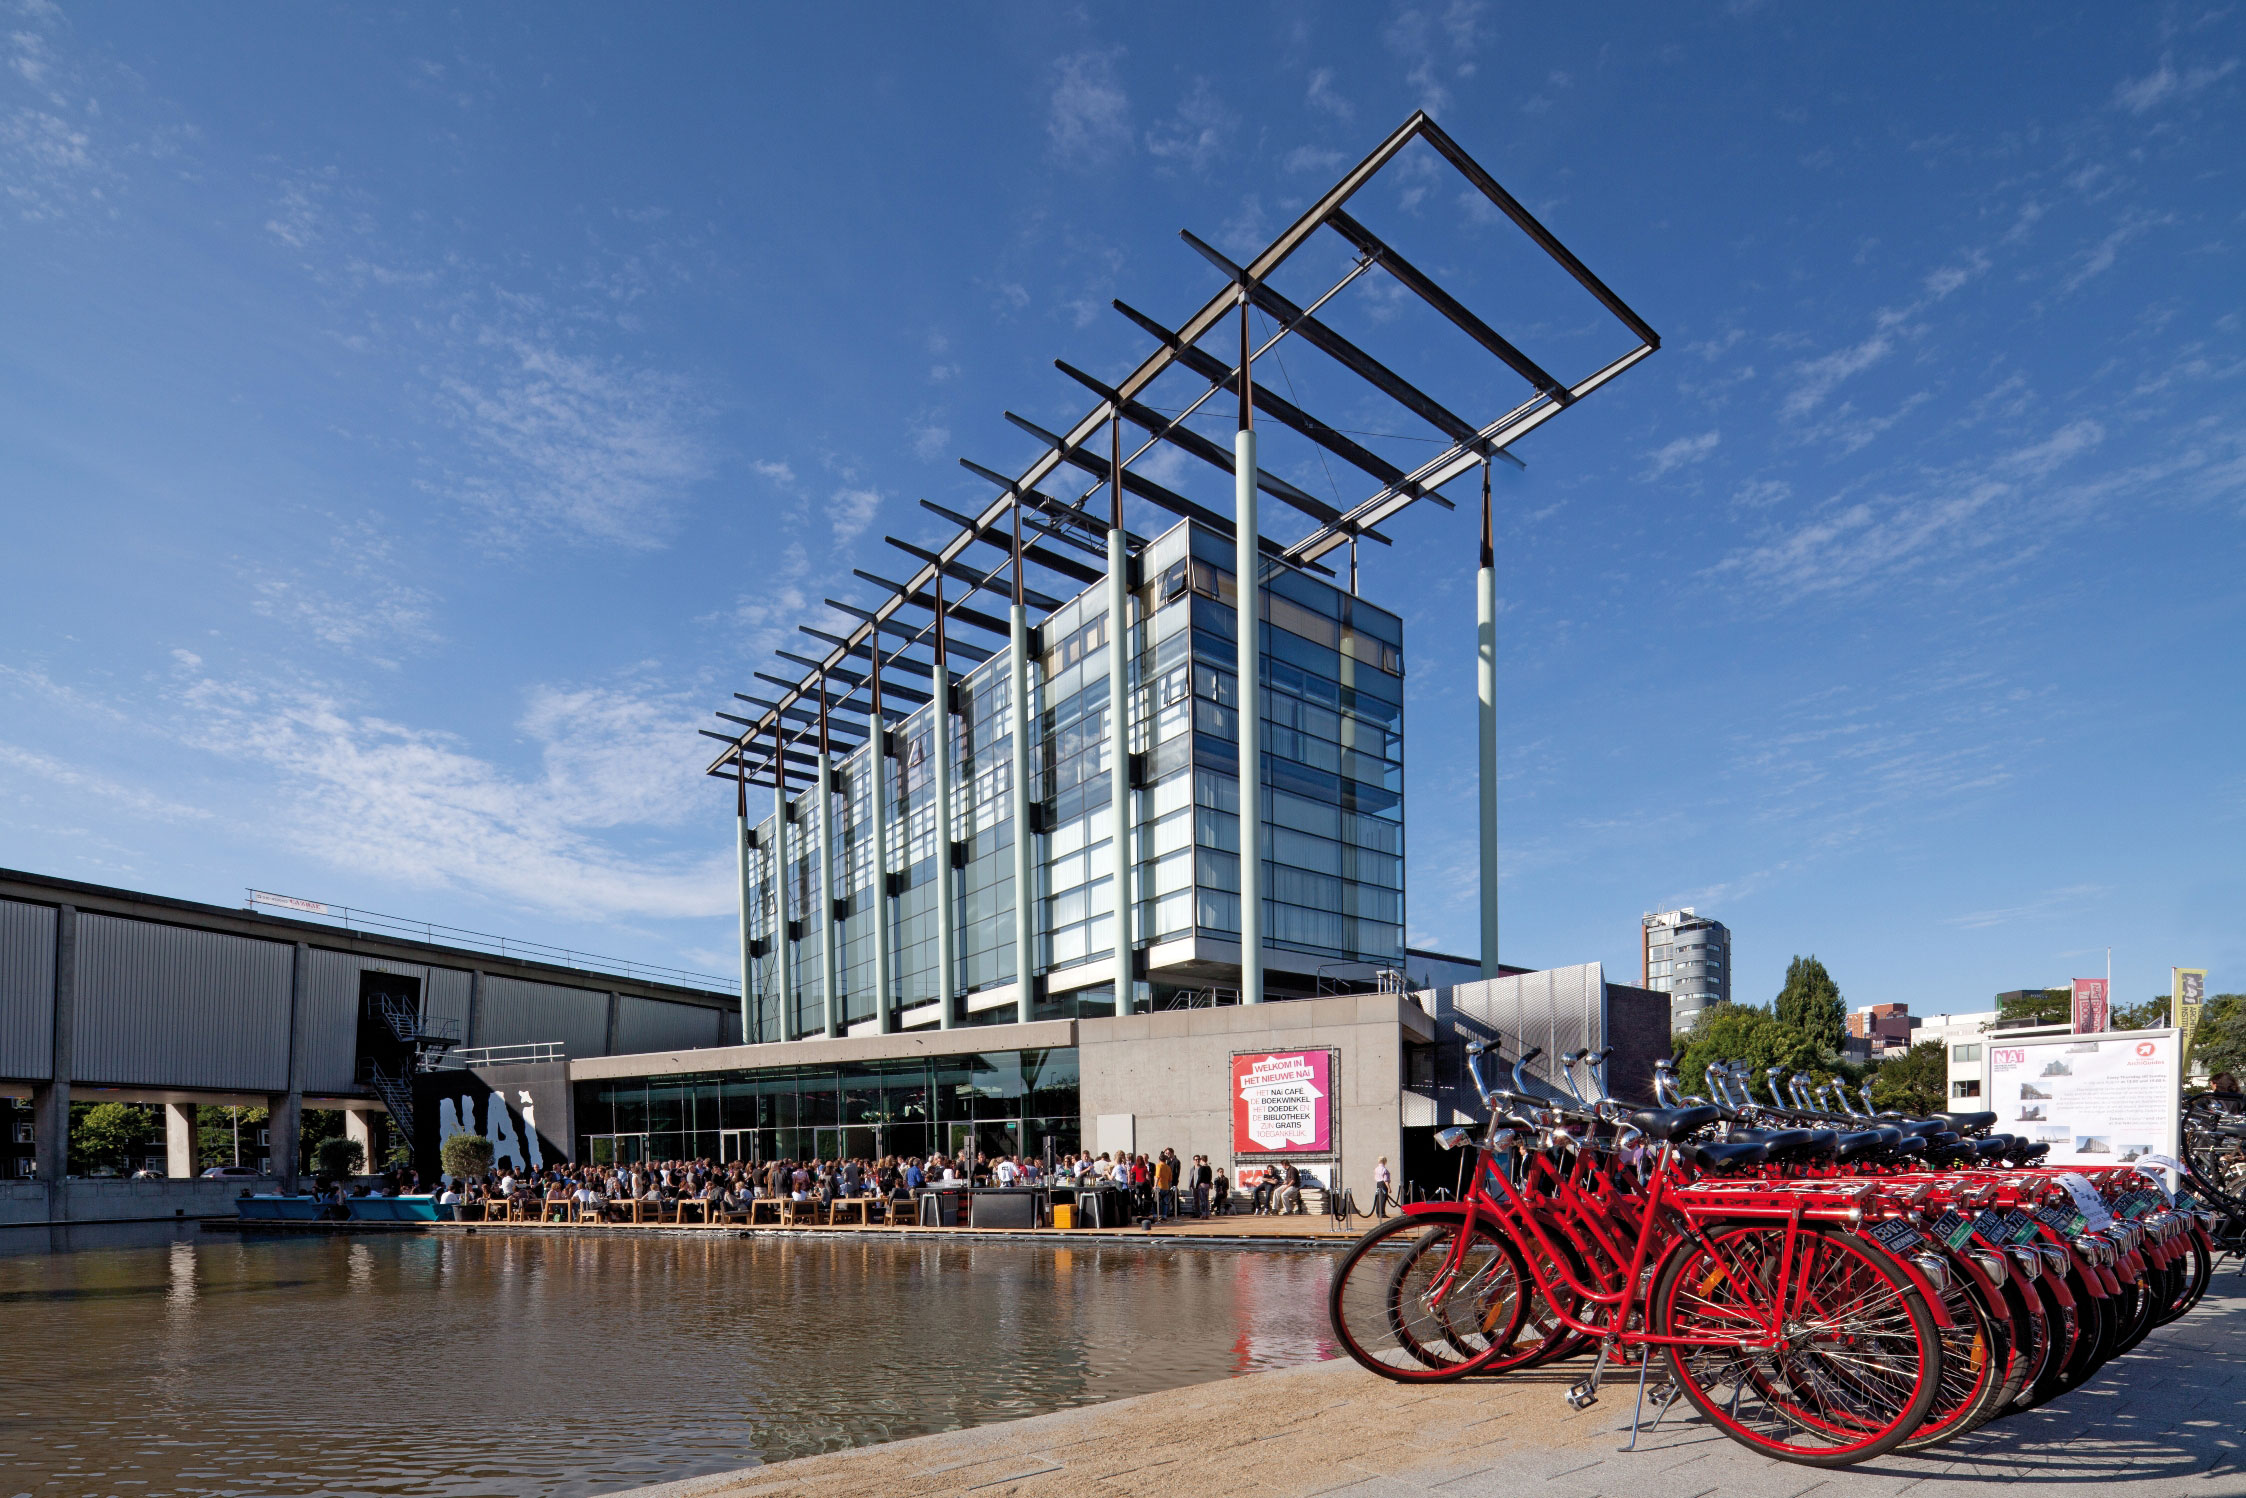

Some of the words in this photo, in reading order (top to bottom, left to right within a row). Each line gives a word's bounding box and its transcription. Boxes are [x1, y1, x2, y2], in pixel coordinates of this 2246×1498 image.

[1254, 1061, 1292, 1073] WELKOM
[1294, 1059, 1303, 1068] IN
[1244, 1076, 1261, 1086] HET
[1261, 1071, 1295, 1083] NIEUWE
[1296, 1069, 1311, 1078] NAi
[1271, 1088, 1284, 1096] NAi
[1261, 1096, 1311, 1104] BOEKWINKEL
[1267, 1105, 1299, 1113] DOEDEK
[1263, 1113, 1311, 1121] BIBLIOTHEEK
[1275, 1121, 1302, 1129] GRATIS
[2009, 1211, 2026, 1228] 720
[1873, 1227, 1893, 1241] CB
[1886, 1219, 1909, 1234] 031
